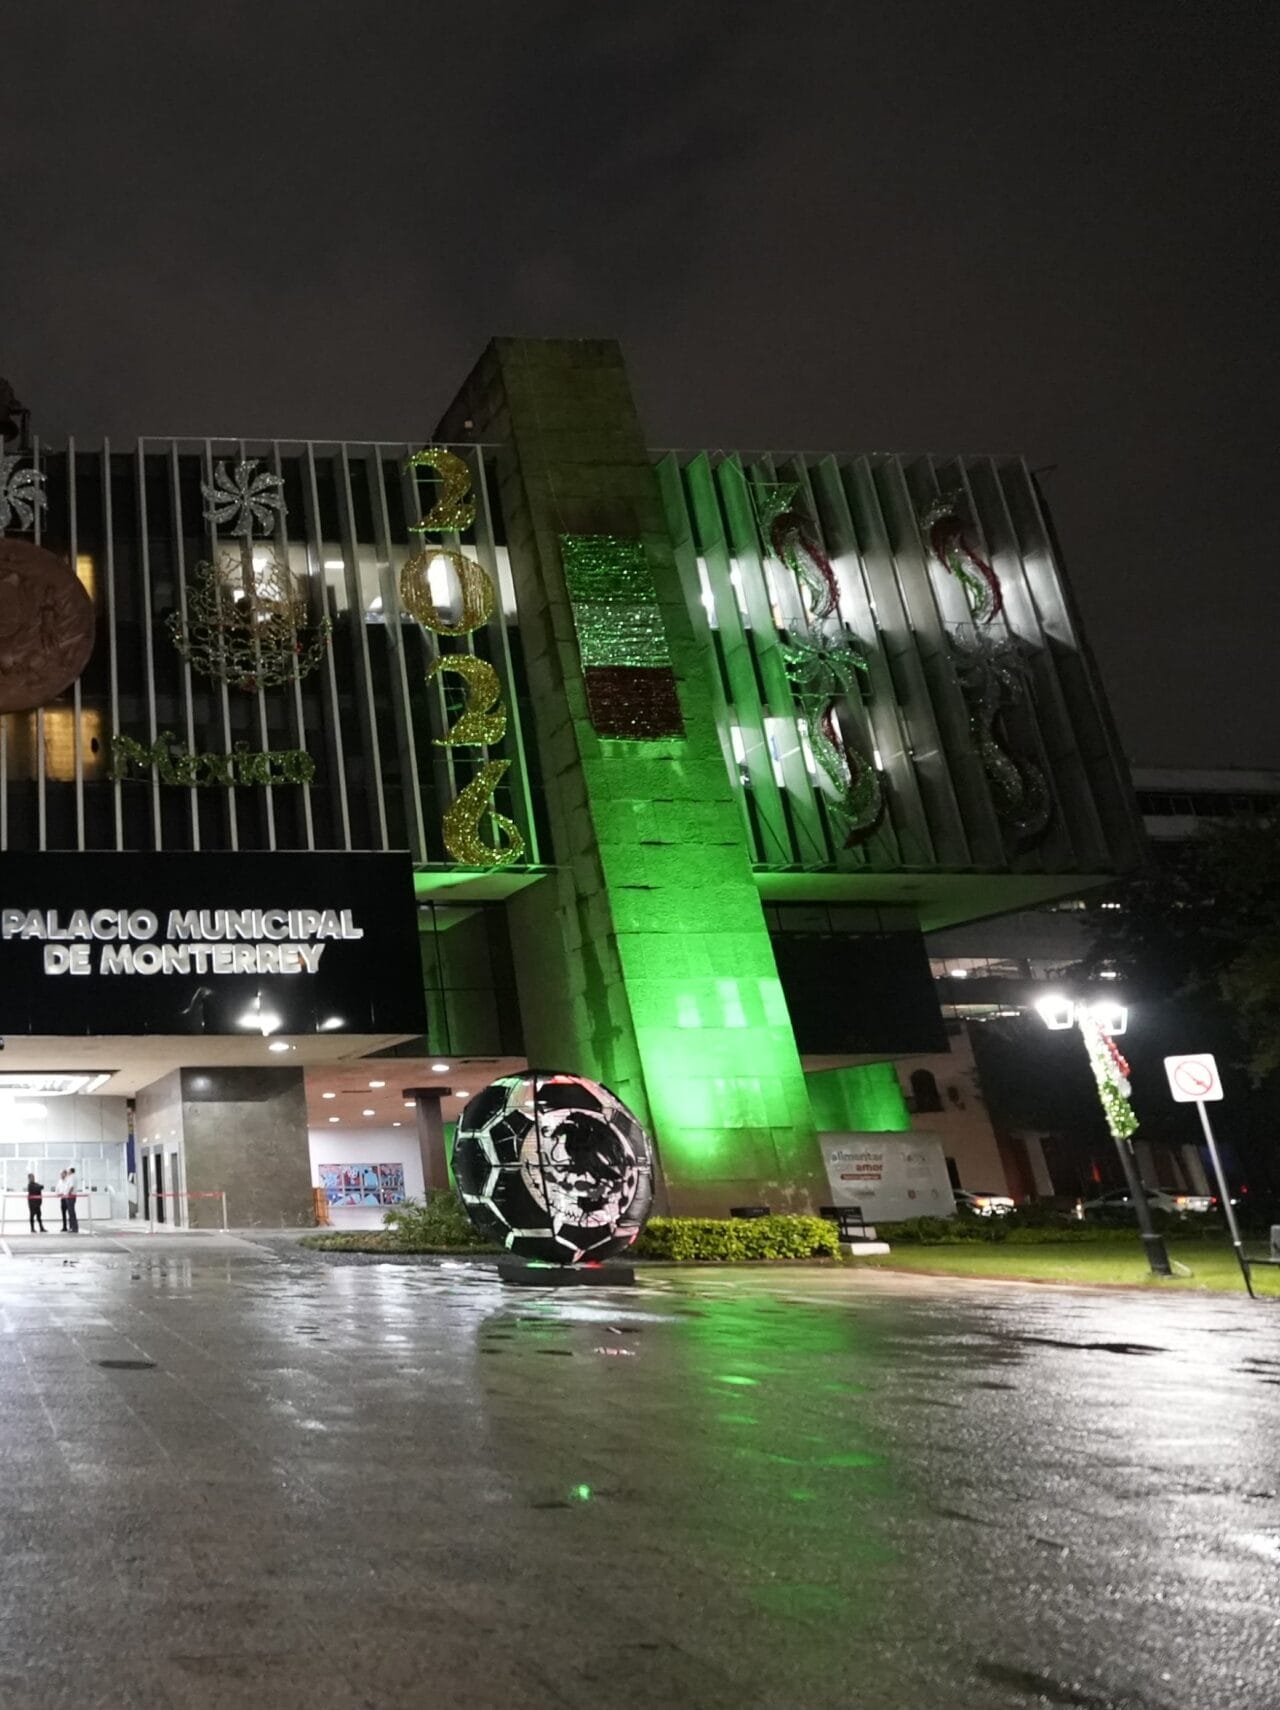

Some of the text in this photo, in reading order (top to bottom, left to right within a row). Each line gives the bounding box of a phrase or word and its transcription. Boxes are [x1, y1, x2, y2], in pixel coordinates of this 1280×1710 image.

[402, 447, 525, 867] 2026
[1, 908, 365, 940] PALACIO MUNICIPAL
[43, 943, 326, 975] DE MONTERREY
[855, 1163, 883, 1172] amor
